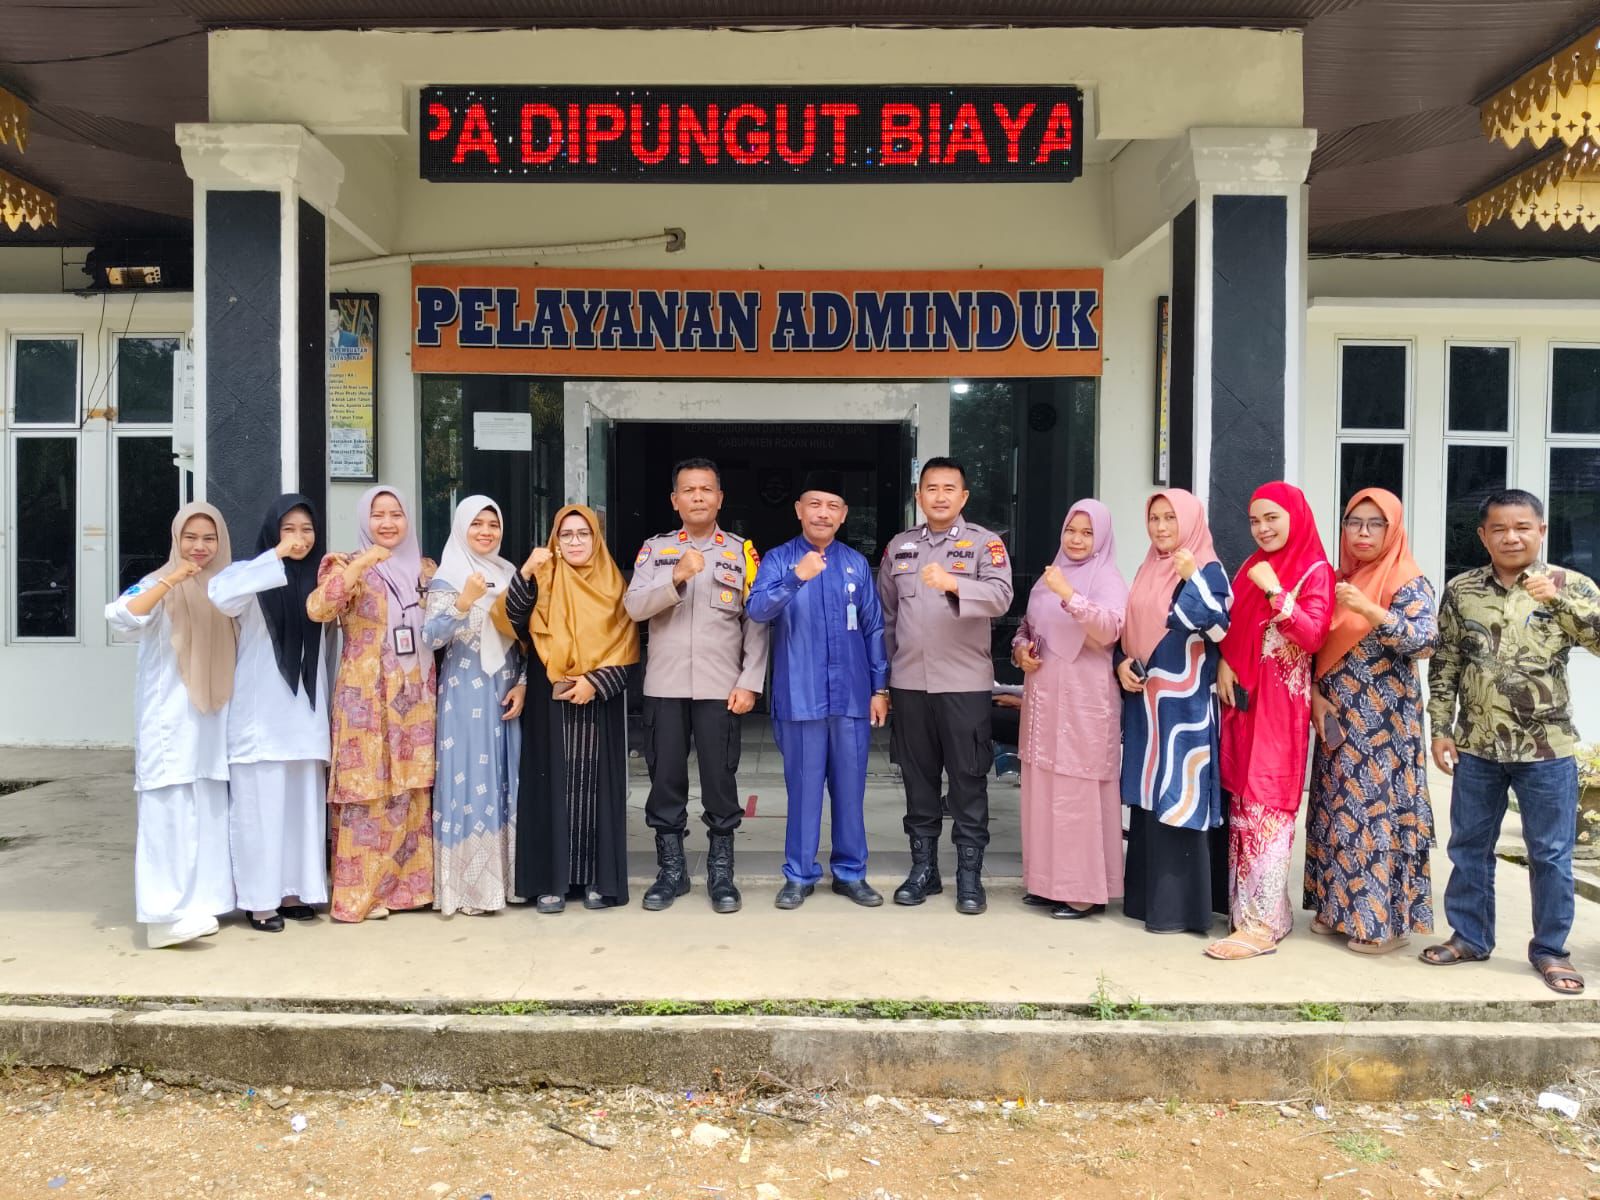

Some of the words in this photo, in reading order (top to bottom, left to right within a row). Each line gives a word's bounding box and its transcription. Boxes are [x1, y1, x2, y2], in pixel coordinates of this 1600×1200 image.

[520, 103, 859, 165] DIPUNGUT
[881, 103, 1073, 165] BIAYA
[416, 286, 761, 352] PELAYANAN
[770, 289, 1099, 352] ADMINDUK
[717, 438, 773, 449] KABUPATEN
[774, 438, 808, 449] ROKAN
[810, 438, 835, 449] HULU
[947, 550, 975, 559] POLRI
[715, 561, 743, 574] POLRI
